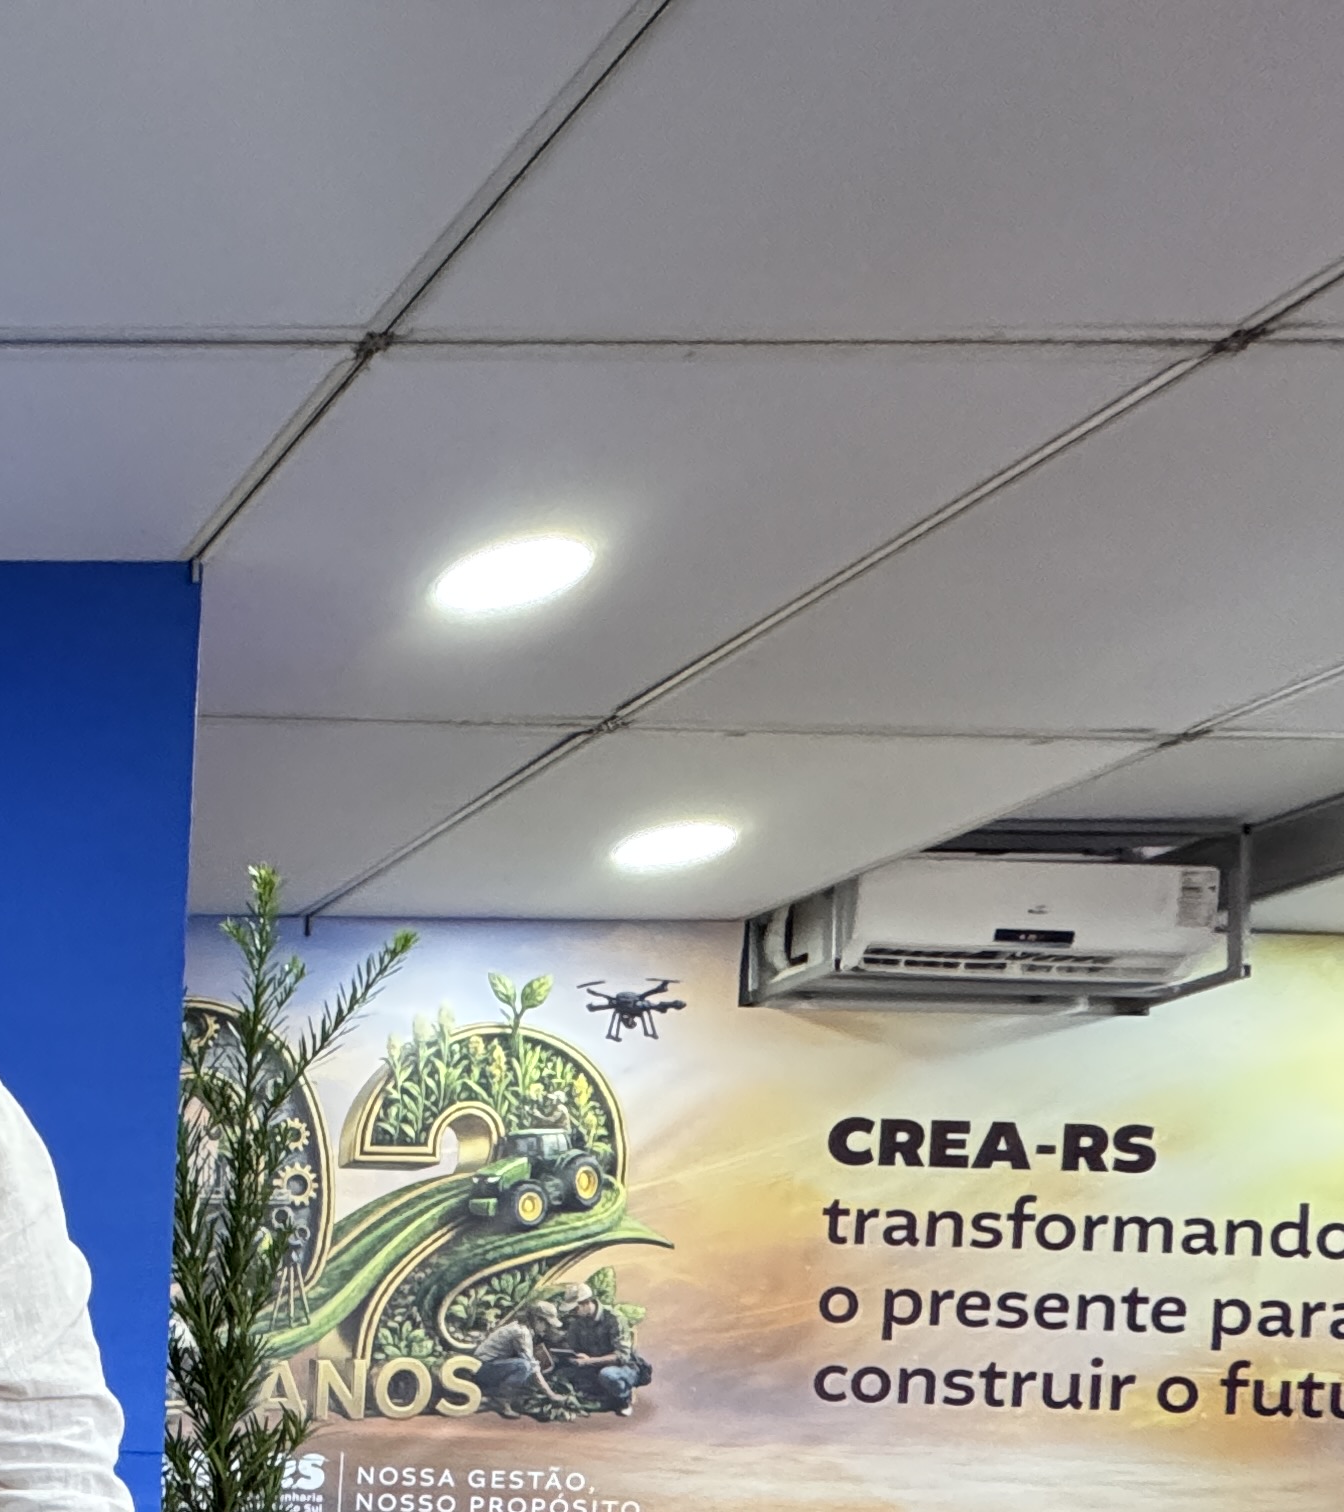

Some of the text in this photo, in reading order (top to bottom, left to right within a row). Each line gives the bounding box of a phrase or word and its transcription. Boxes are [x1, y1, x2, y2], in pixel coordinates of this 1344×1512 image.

[828, 1116, 1157, 1173] CREA-RS
[822, 1194, 1344, 1260] transformando
[818, 1285, 1344, 1350] o presente para
[256, 1355, 483, 1420] ANOS
[813, 1357, 1136, 1411] construir
[1157, 1374, 1199, 1413] o
[356, 1466, 455, 1488] NOSSA
[467, 1465, 596, 1495] GESTÃO,
